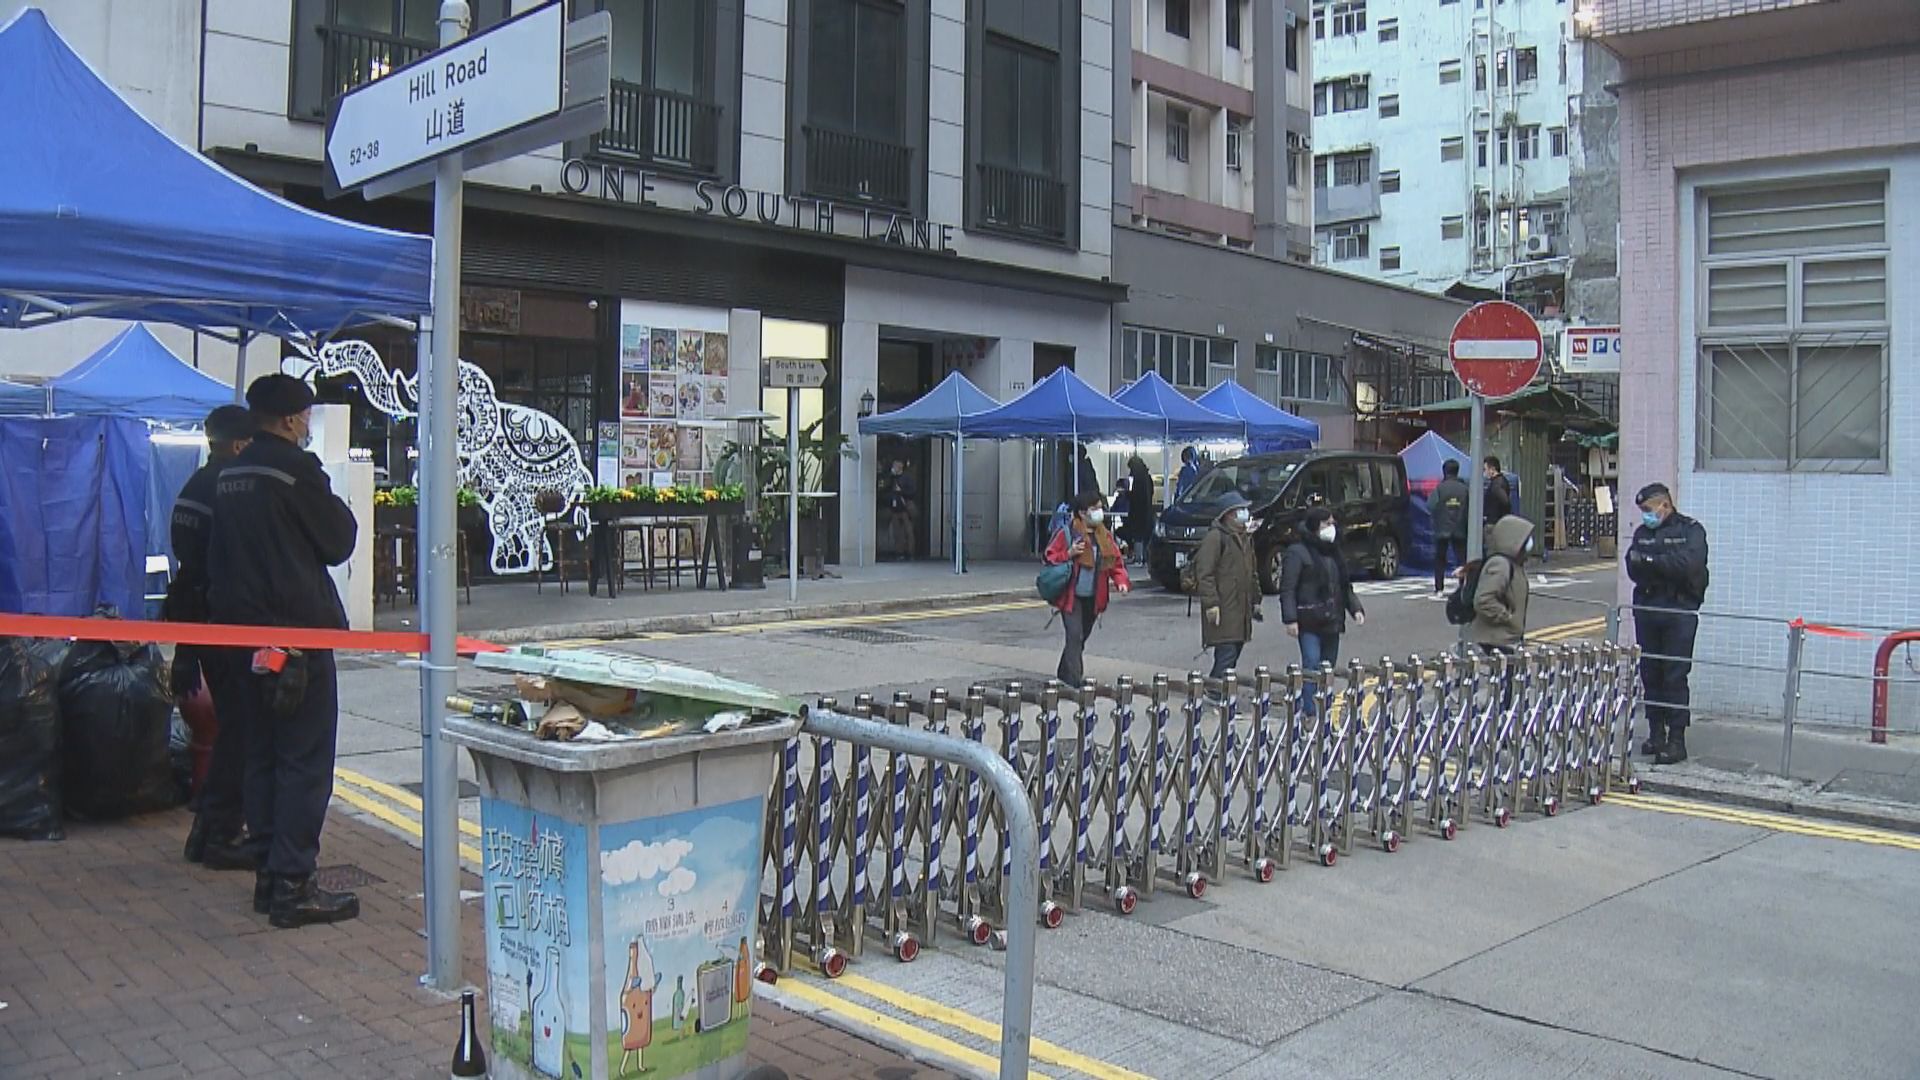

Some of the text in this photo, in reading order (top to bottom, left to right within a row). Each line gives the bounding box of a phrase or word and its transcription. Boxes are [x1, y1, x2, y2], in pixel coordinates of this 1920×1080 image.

[409, 48, 488, 104] Hill Road
[425, 97, 466, 146] 山道
[559, 158, 958, 257] ONE SOUTH LANE
[775, 360, 815, 370] South Lane
[492, 880, 572, 948] 回收桶
[667, 897, 675, 911] 3
[721, 899, 729, 913] 4
